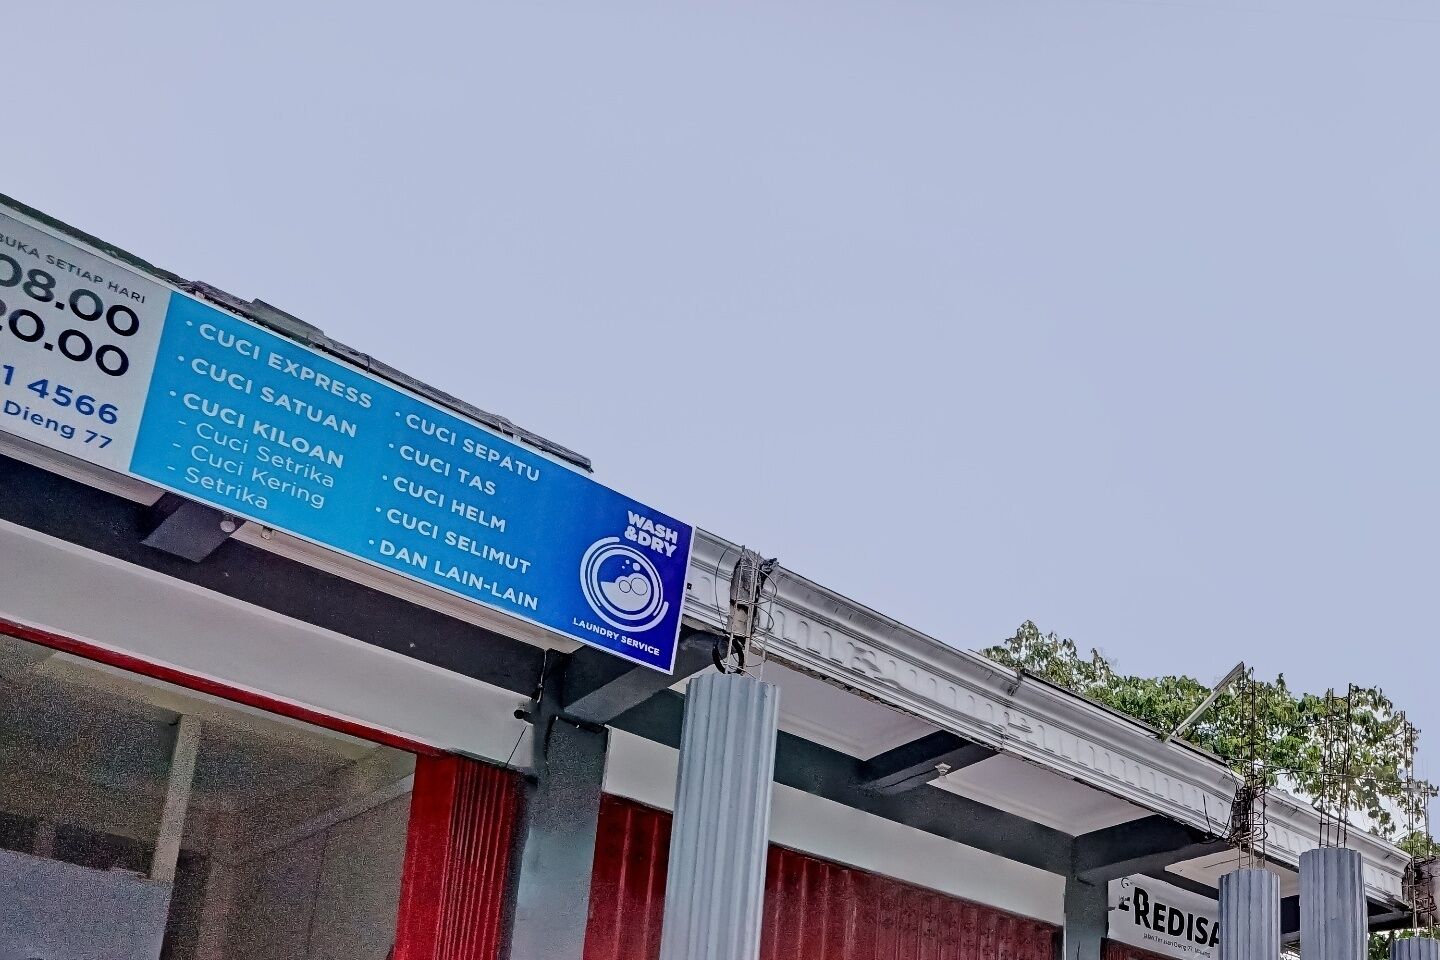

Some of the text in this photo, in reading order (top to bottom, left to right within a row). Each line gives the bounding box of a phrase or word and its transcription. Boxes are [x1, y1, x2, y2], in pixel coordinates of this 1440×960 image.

[0, 253, 140, 337] 08.00
[46, 254, 103, 284] SETIAP
[108, 281, 146, 304] HARI
[0, 300, 129, 376] 0.00
[199, 323, 373, 409] CUCI EXPRESS
[4, 400, 113, 449] Dieng 77
[27, 379, 119, 425] 4566
[191, 358, 357, 438] CUCI SATUAN
[183, 393, 344, 469] CUCI KILOAN
[196, 422, 334, 488] Cuci Setrika
[406, 414, 540, 482] CUCI SEPATU
[184, 466, 268, 509] Setrika
[191, 445, 325, 509] Cuci Kering
[399, 445, 497, 496] CUCI TAS
[393, 476, 506, 533] CUCI HELM
[627, 510, 678, 544] WASH
[386, 508, 531, 574] CUCI SELIMUT
[624, 525, 678, 558] &DRY
[379, 539, 539, 611] DAN LAIN-LAIN
[573, 617, 660, 656] LAUNDRY SERVICE
